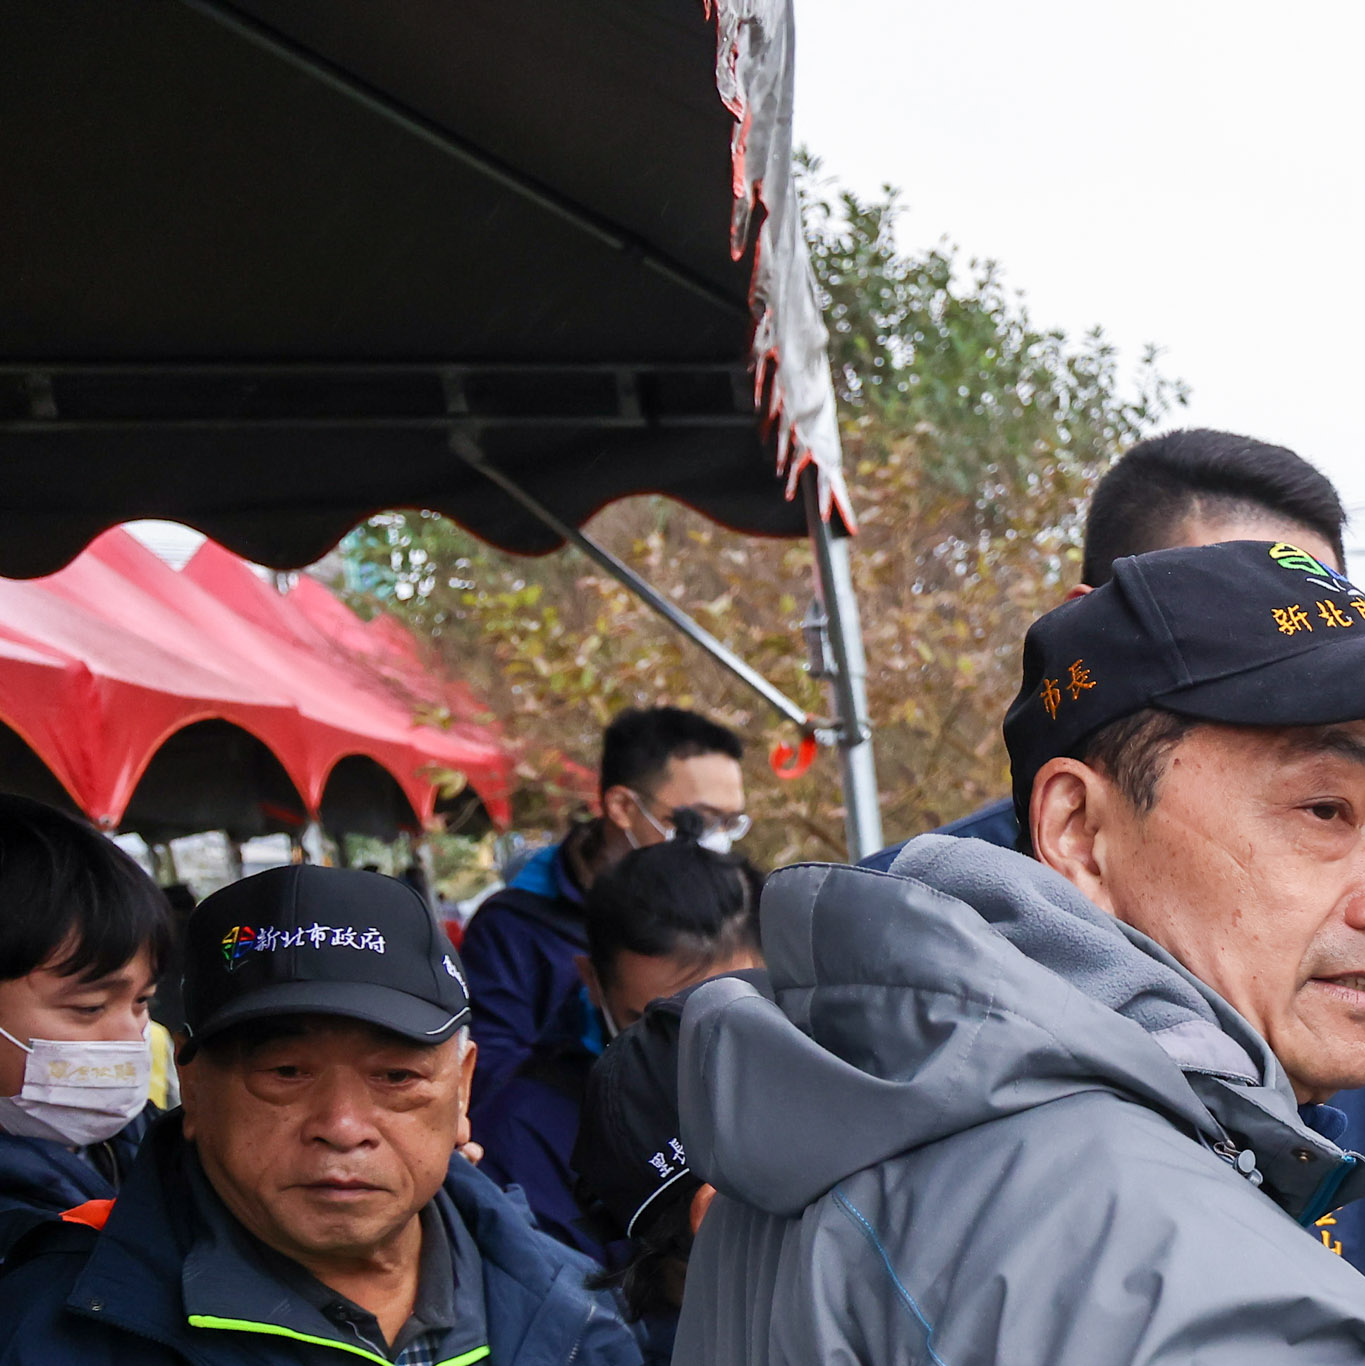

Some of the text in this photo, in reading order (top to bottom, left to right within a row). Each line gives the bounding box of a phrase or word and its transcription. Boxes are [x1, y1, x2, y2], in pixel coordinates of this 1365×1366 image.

[1040, 658, 1097, 720] 市長
[254, 922, 387, 954] 新北市政府
[648, 1137, 686, 1178] 里長
